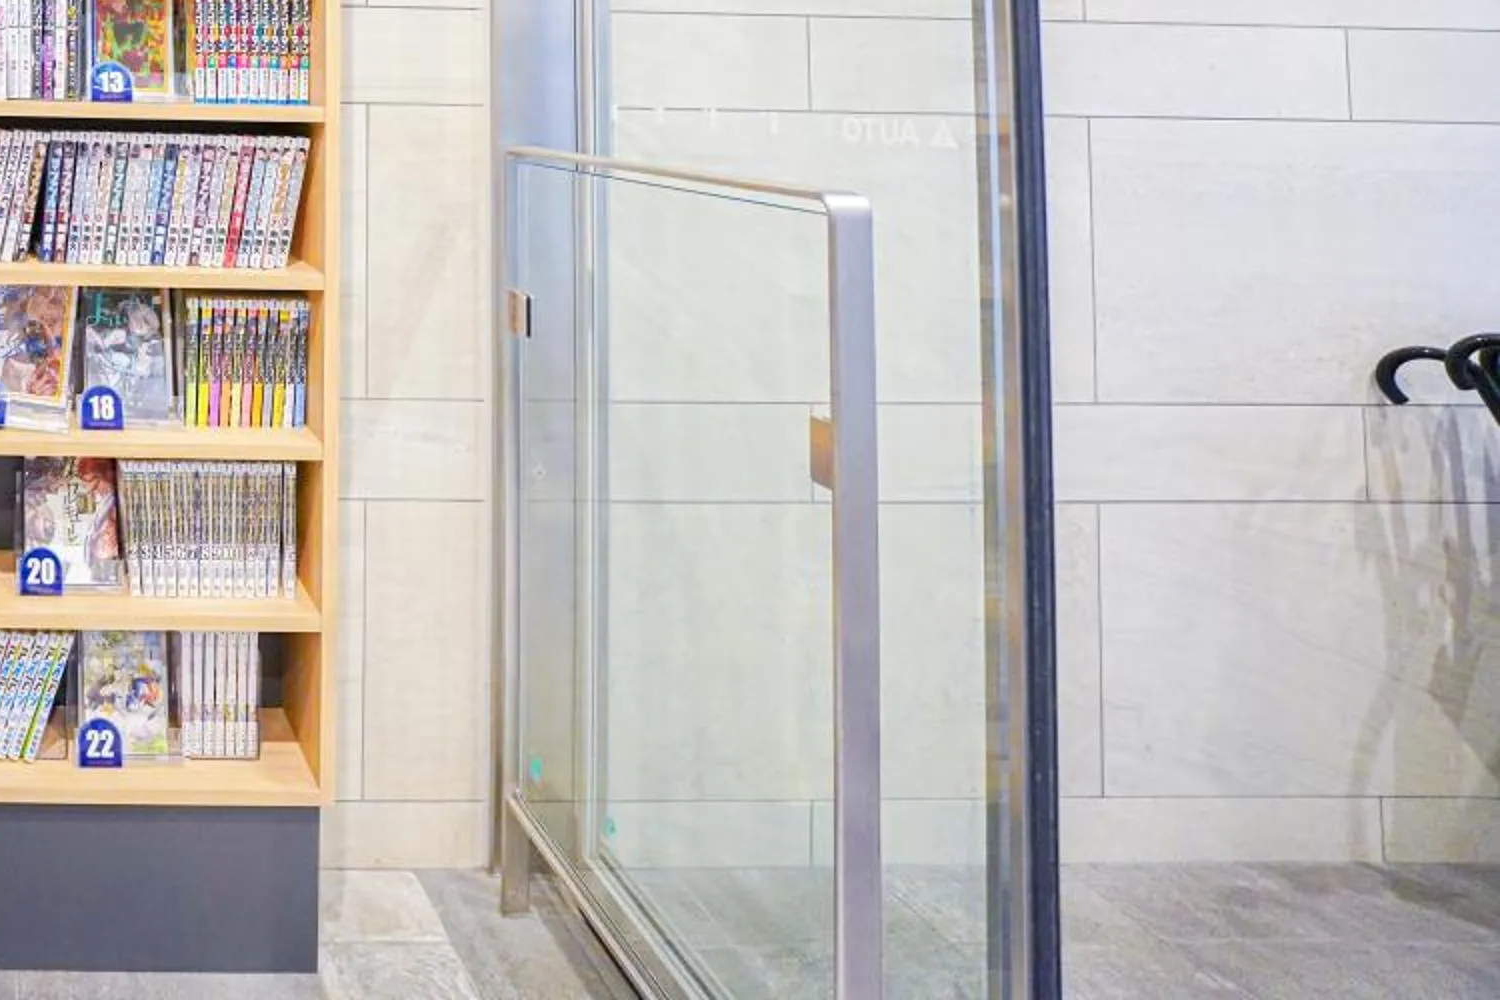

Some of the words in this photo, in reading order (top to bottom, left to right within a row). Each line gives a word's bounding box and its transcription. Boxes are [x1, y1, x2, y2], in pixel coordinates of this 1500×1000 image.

[98, 71, 124, 93] 13
[89, 395, 115, 419] 18
[27, 556, 55, 585] 20
[86, 729, 115, 758] 22
